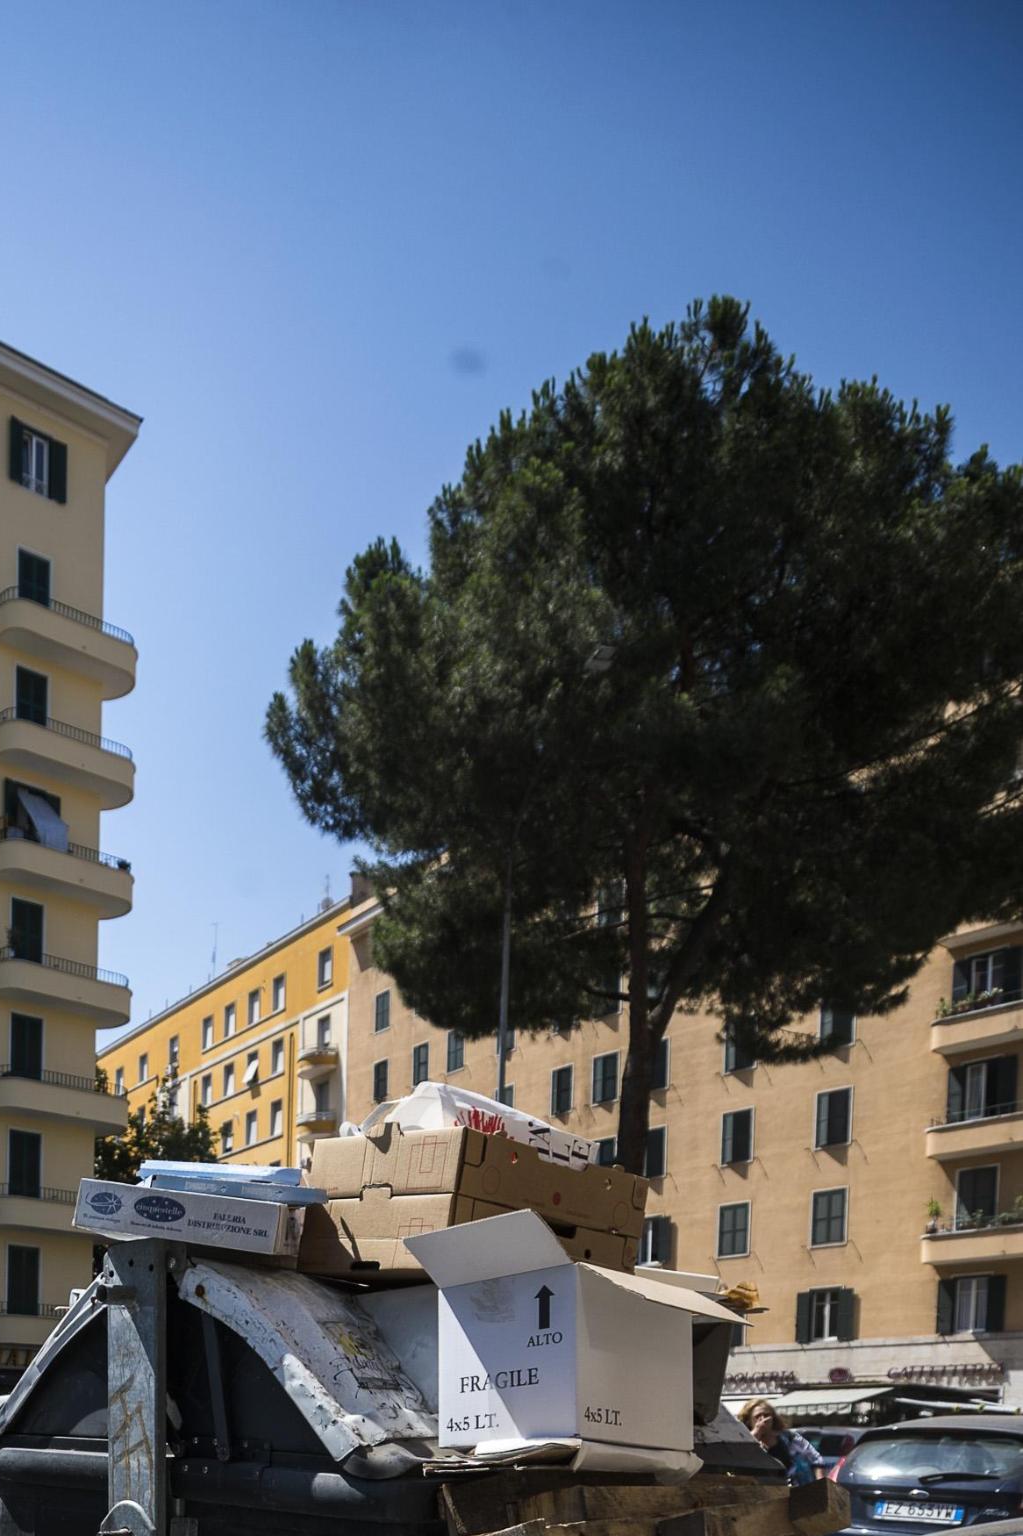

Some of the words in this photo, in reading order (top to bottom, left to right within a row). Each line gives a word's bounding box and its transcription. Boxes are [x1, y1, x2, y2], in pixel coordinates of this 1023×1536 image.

[527, 1331, 563, 1348] ALTO
[460, 1368, 540, 1393] FRAGILE
[447, 1416, 470, 1432] 4x5
[475, 1414, 499, 1430] LT.
[584, 1406, 602, 1423] 4x5
[605, 1409, 622, 1426] LT.
